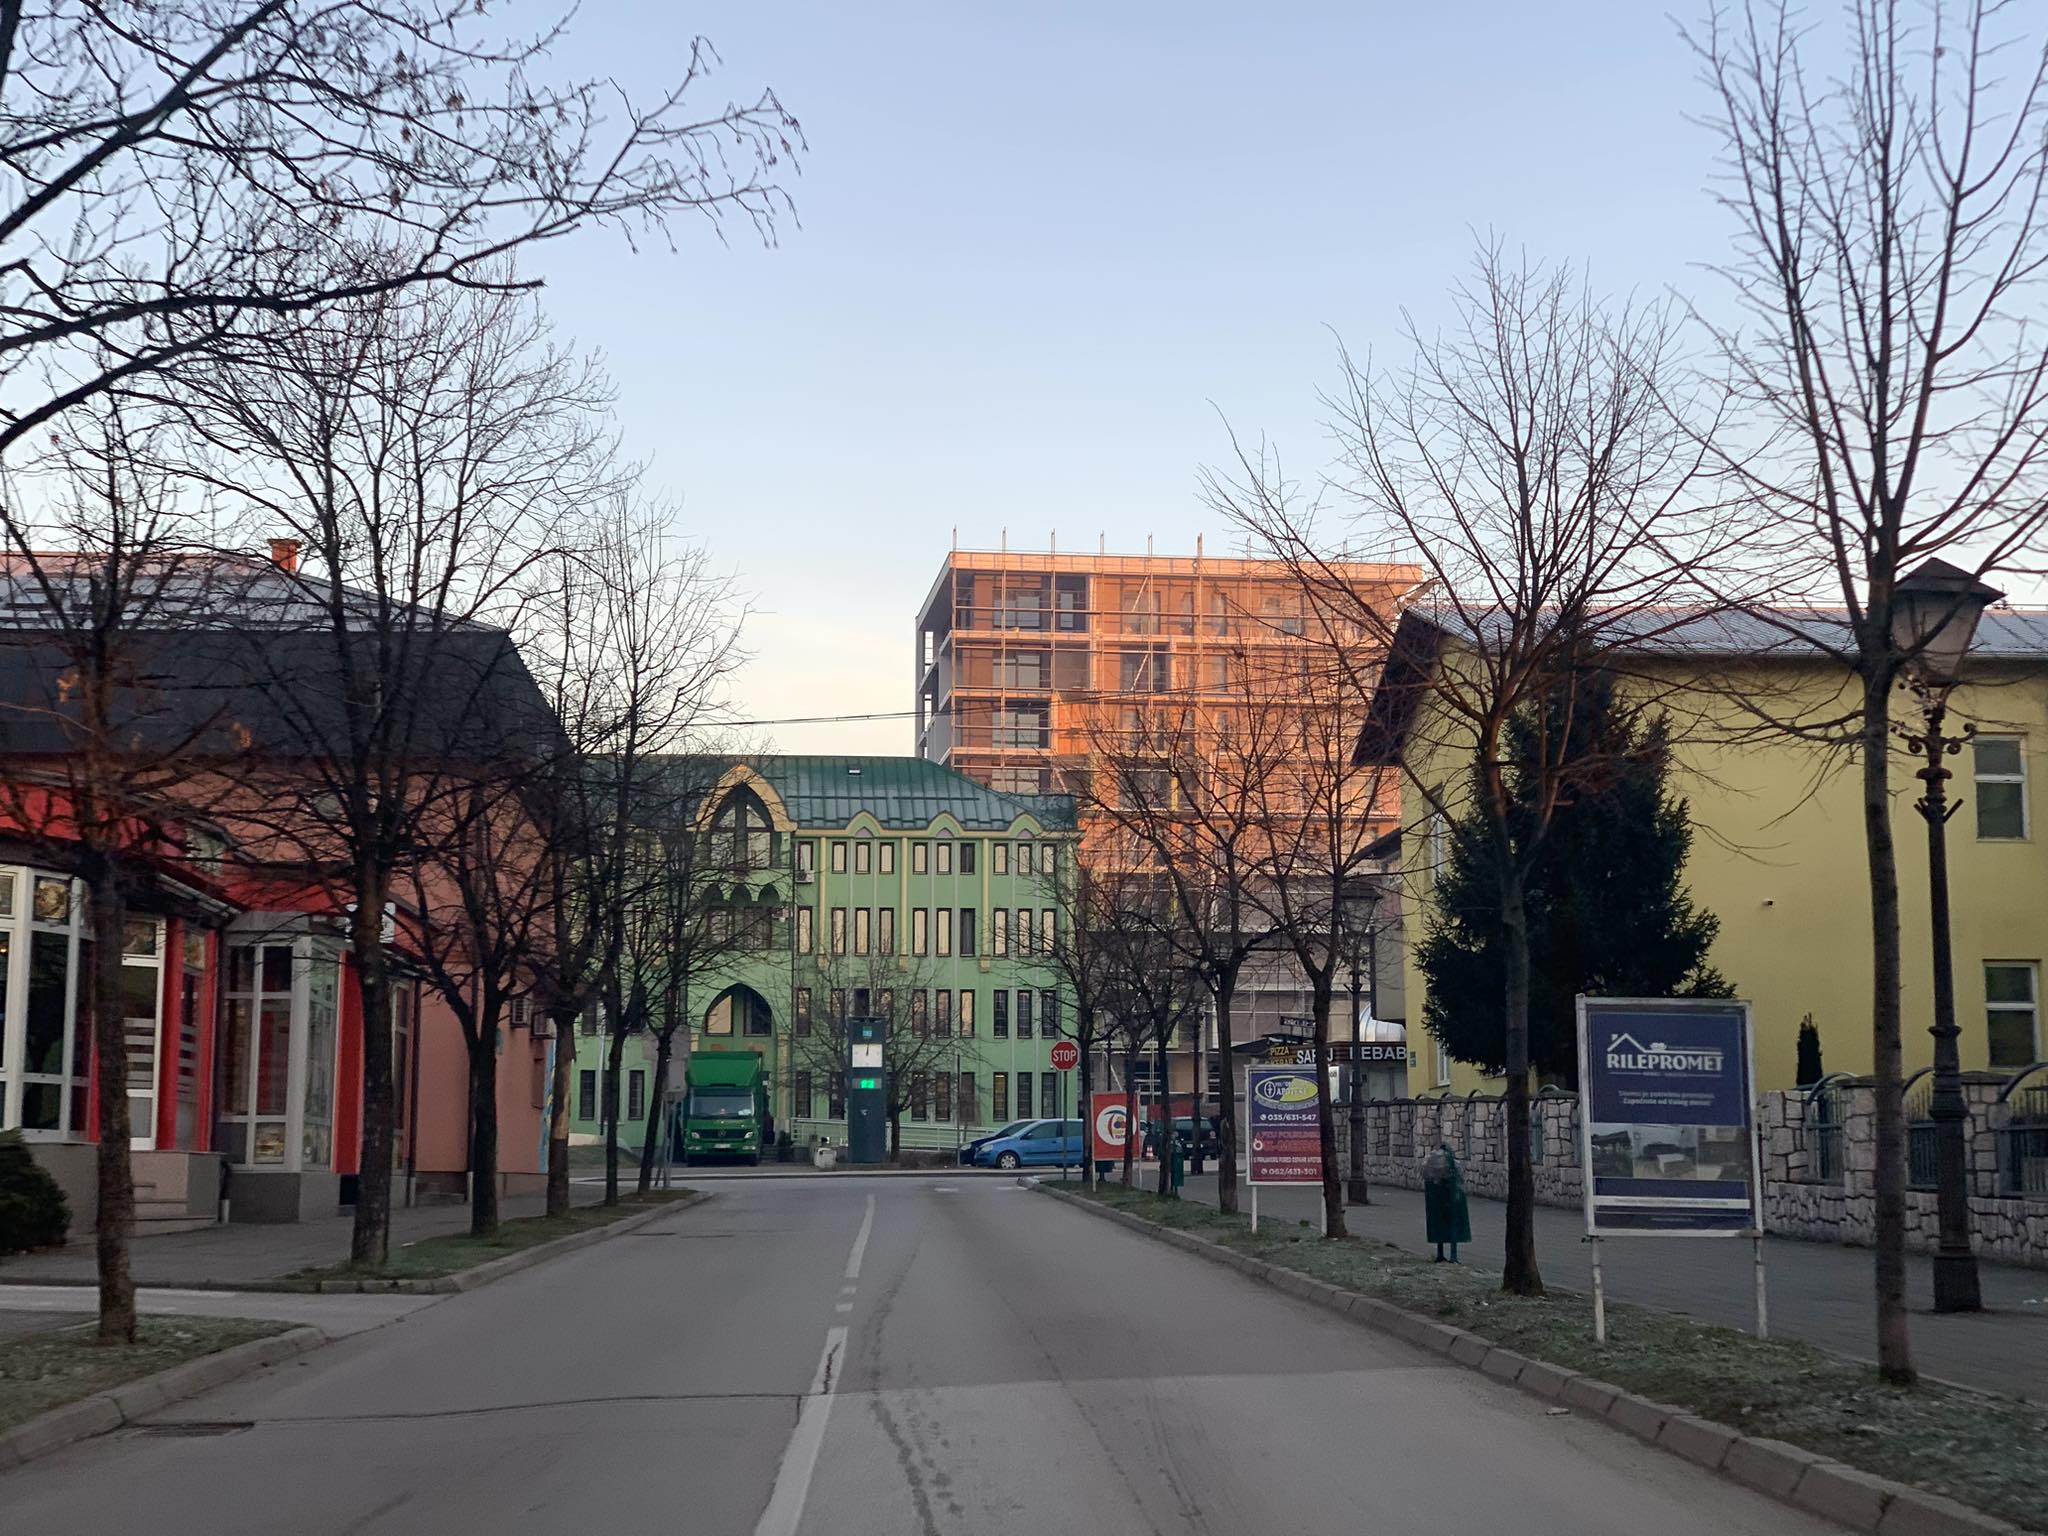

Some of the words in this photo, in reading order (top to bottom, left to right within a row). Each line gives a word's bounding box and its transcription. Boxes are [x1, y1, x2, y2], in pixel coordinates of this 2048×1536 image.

[1052, 1050, 1076, 1062] STOP
[1270, 1046, 1290, 1056] PIZZA
[1296, 1047, 1334, 1064] SAJ
[1349, 1046, 1407, 1060] EBAB
[1606, 1053, 1725, 1072] RILEPROMET
[1267, 1113, 1317, 1121] 035/631-547
